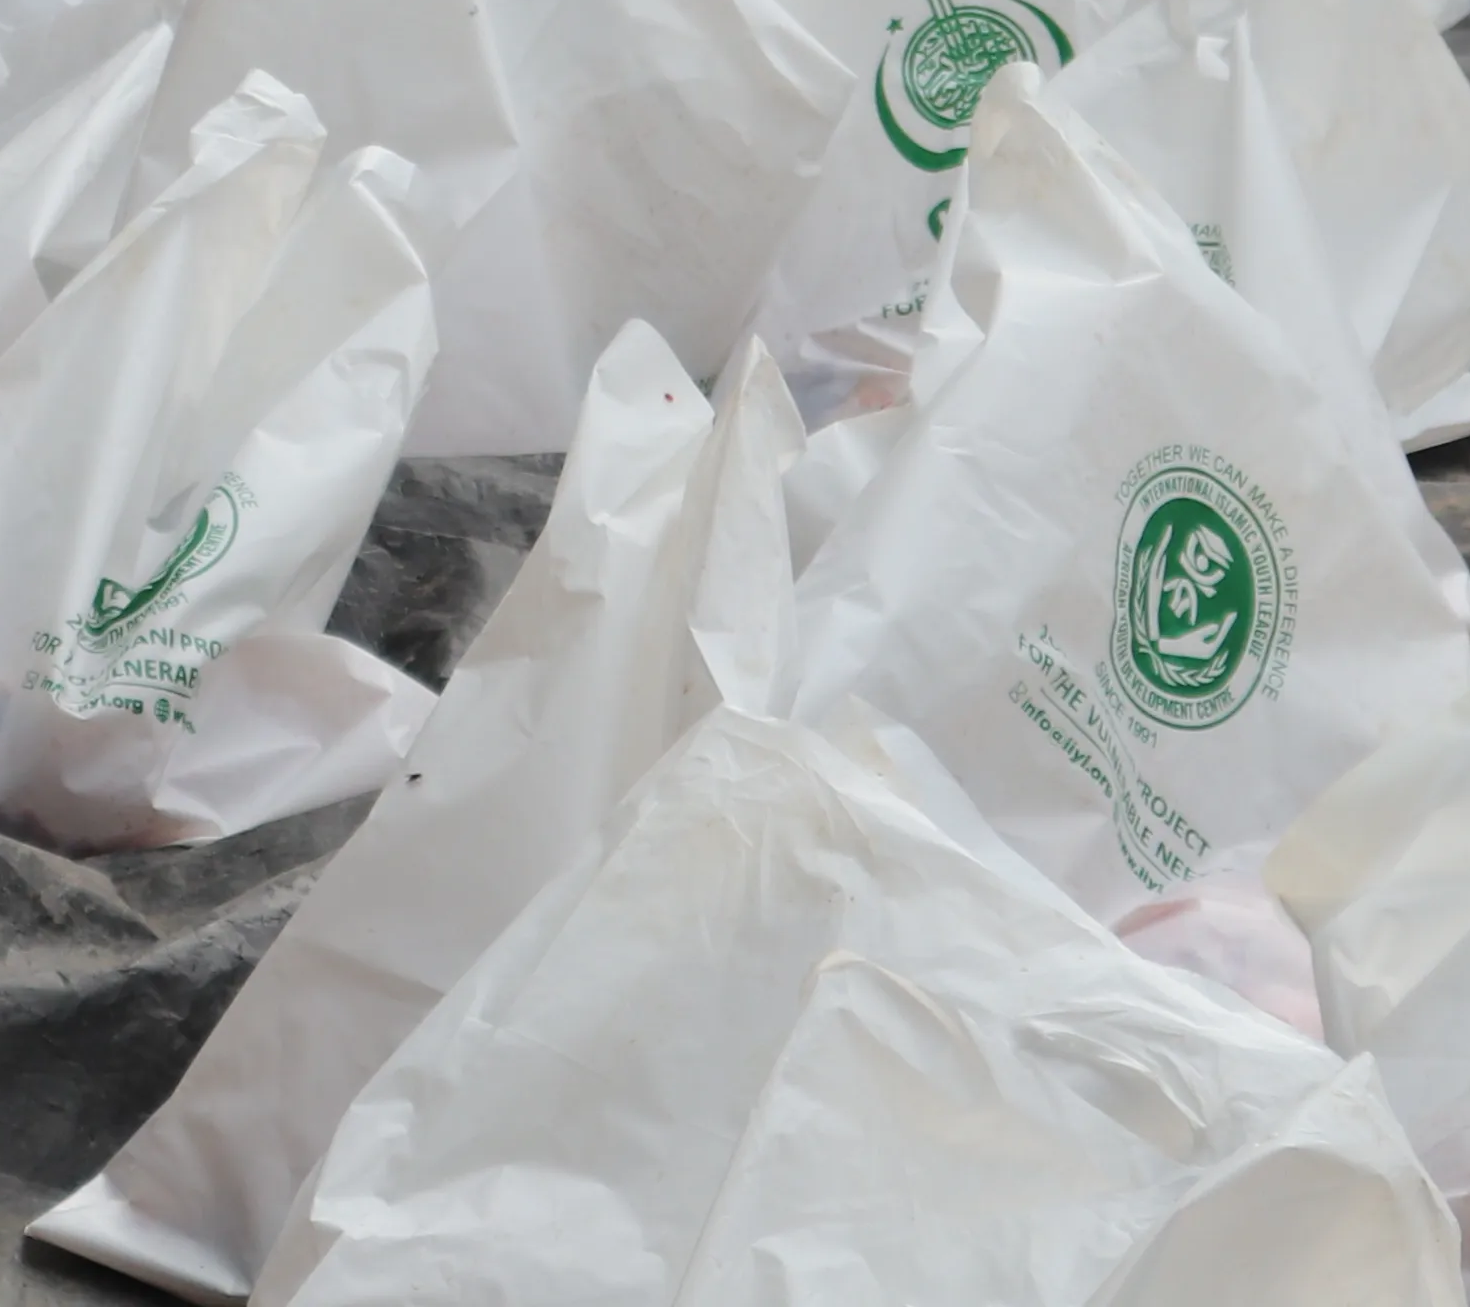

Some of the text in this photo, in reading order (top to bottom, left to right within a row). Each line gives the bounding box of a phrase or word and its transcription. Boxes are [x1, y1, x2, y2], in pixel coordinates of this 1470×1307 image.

[1114, 443, 1299, 703] TOGETHER WE CAN MAKE A DIFFERENCE
[1139, 475, 1273, 661] INTERNATIONAL ISLAMIC YOUTH LEAGUE
[1017, 633, 1055, 676] FOR
[1054, 666, 1088, 713] THE
[1094, 660, 1158, 749] SINCE 1991
[1120, 658, 1195, 721] DEVELOPMENT
[1196, 689, 1236, 720] CENTRE
